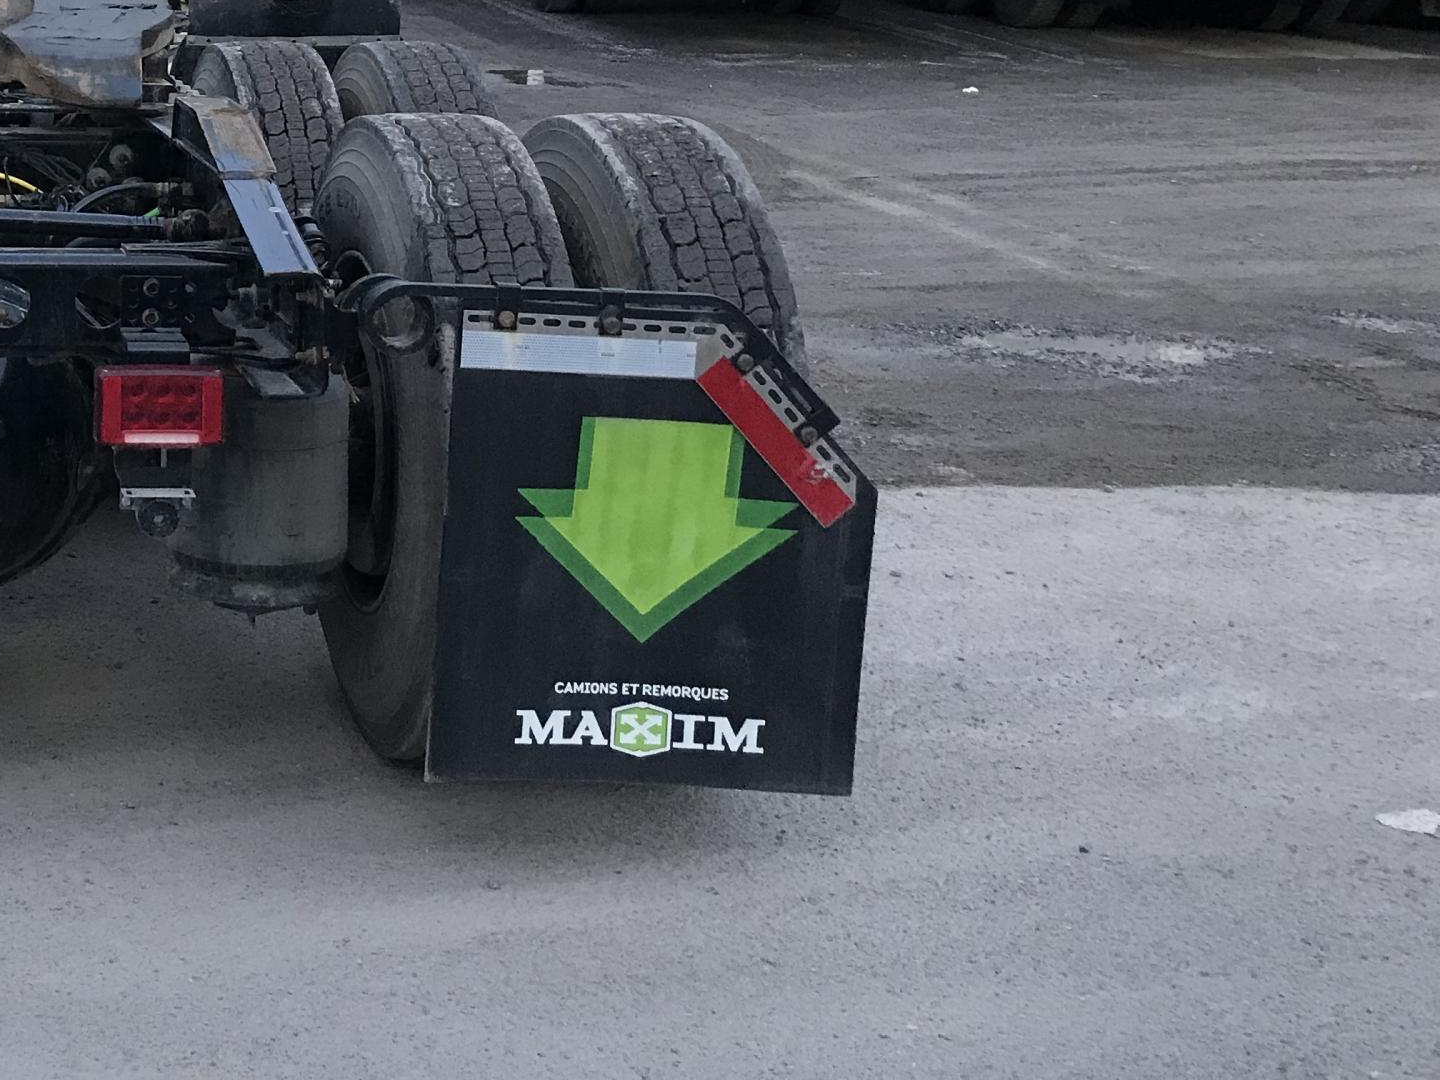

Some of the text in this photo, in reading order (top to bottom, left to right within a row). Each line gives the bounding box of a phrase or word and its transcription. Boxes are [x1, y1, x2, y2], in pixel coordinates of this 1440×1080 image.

[554, 682, 729, 700] CAMIONS ET REMORQUES
[514, 703, 766, 756] MAXIM
